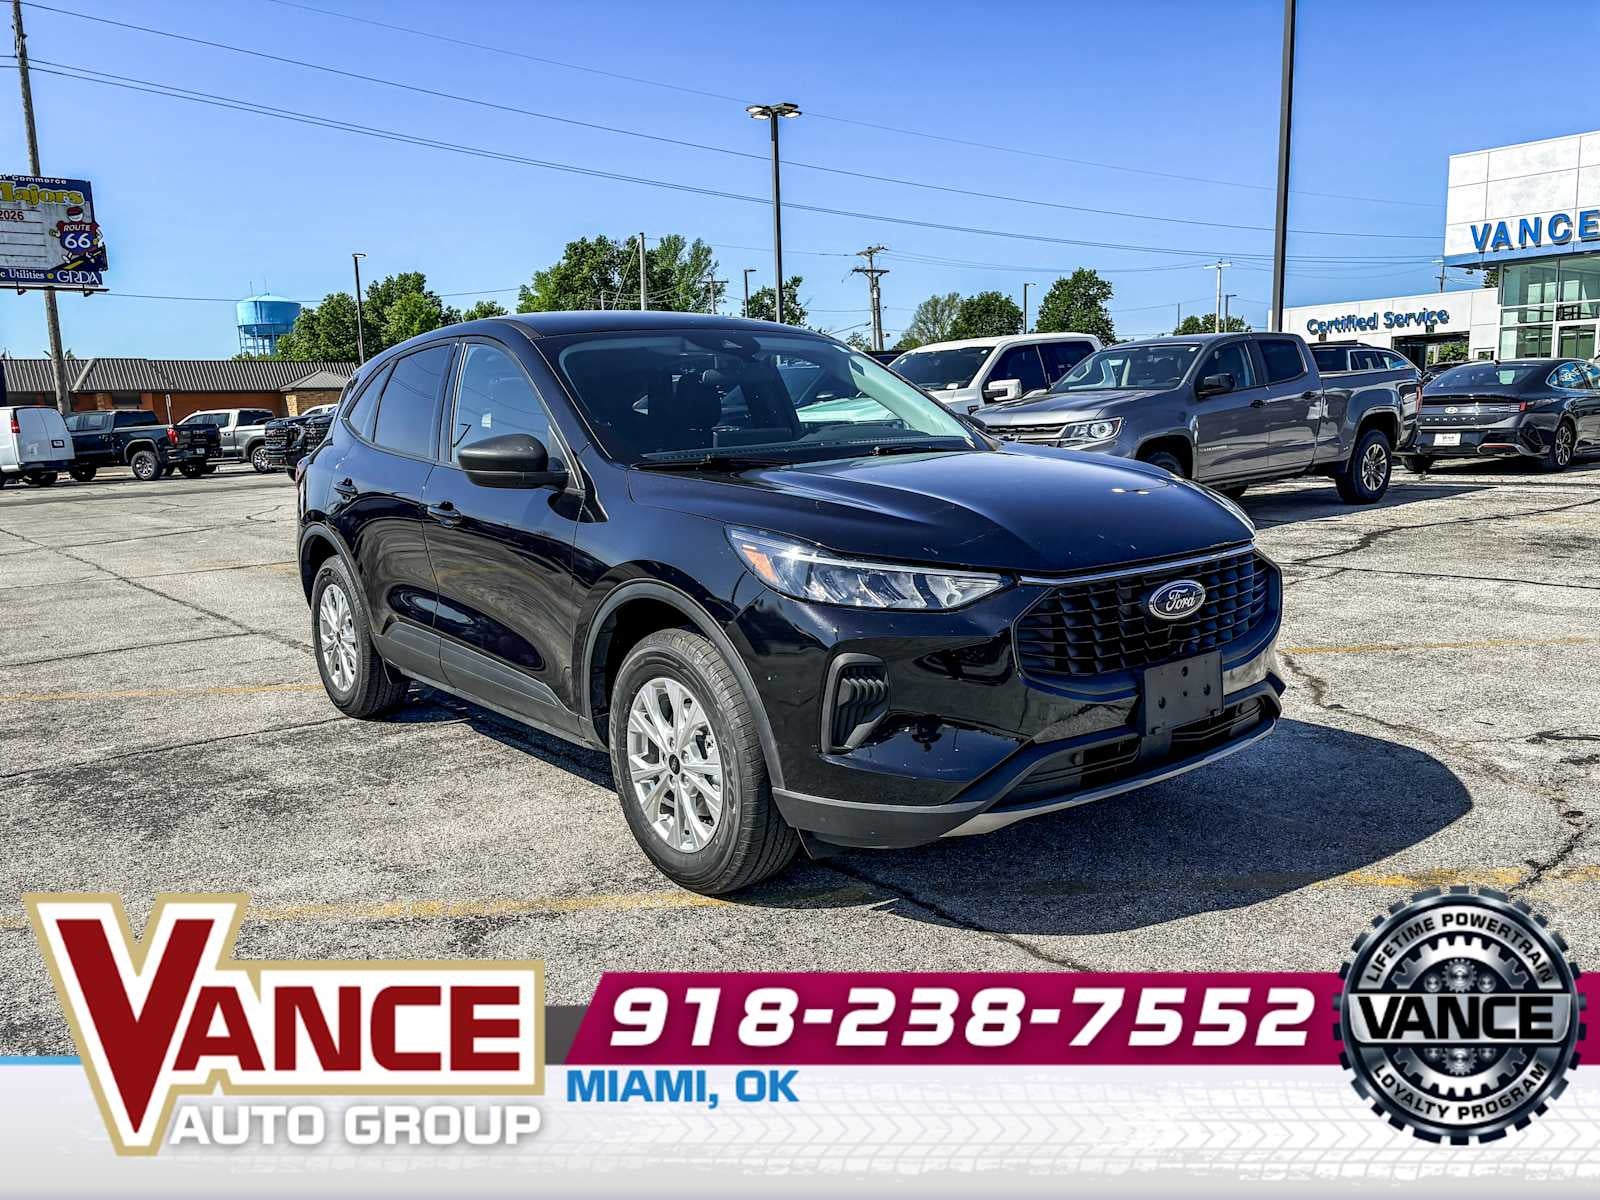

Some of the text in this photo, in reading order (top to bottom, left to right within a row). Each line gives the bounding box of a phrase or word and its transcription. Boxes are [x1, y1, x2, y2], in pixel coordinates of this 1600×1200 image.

[12, 174, 67, 185] Commerce
[63, 224, 91, 232] ROUTE
[1470, 209, 1600, 253] VANCE
[64, 233, 91, 249] 66
[9, 269, 45, 280] Utilities
[56, 270, 100, 284] GRDA
[1307, 308, 1450, 335] Certified Service
[1165, 588, 1196, 612] Ford
